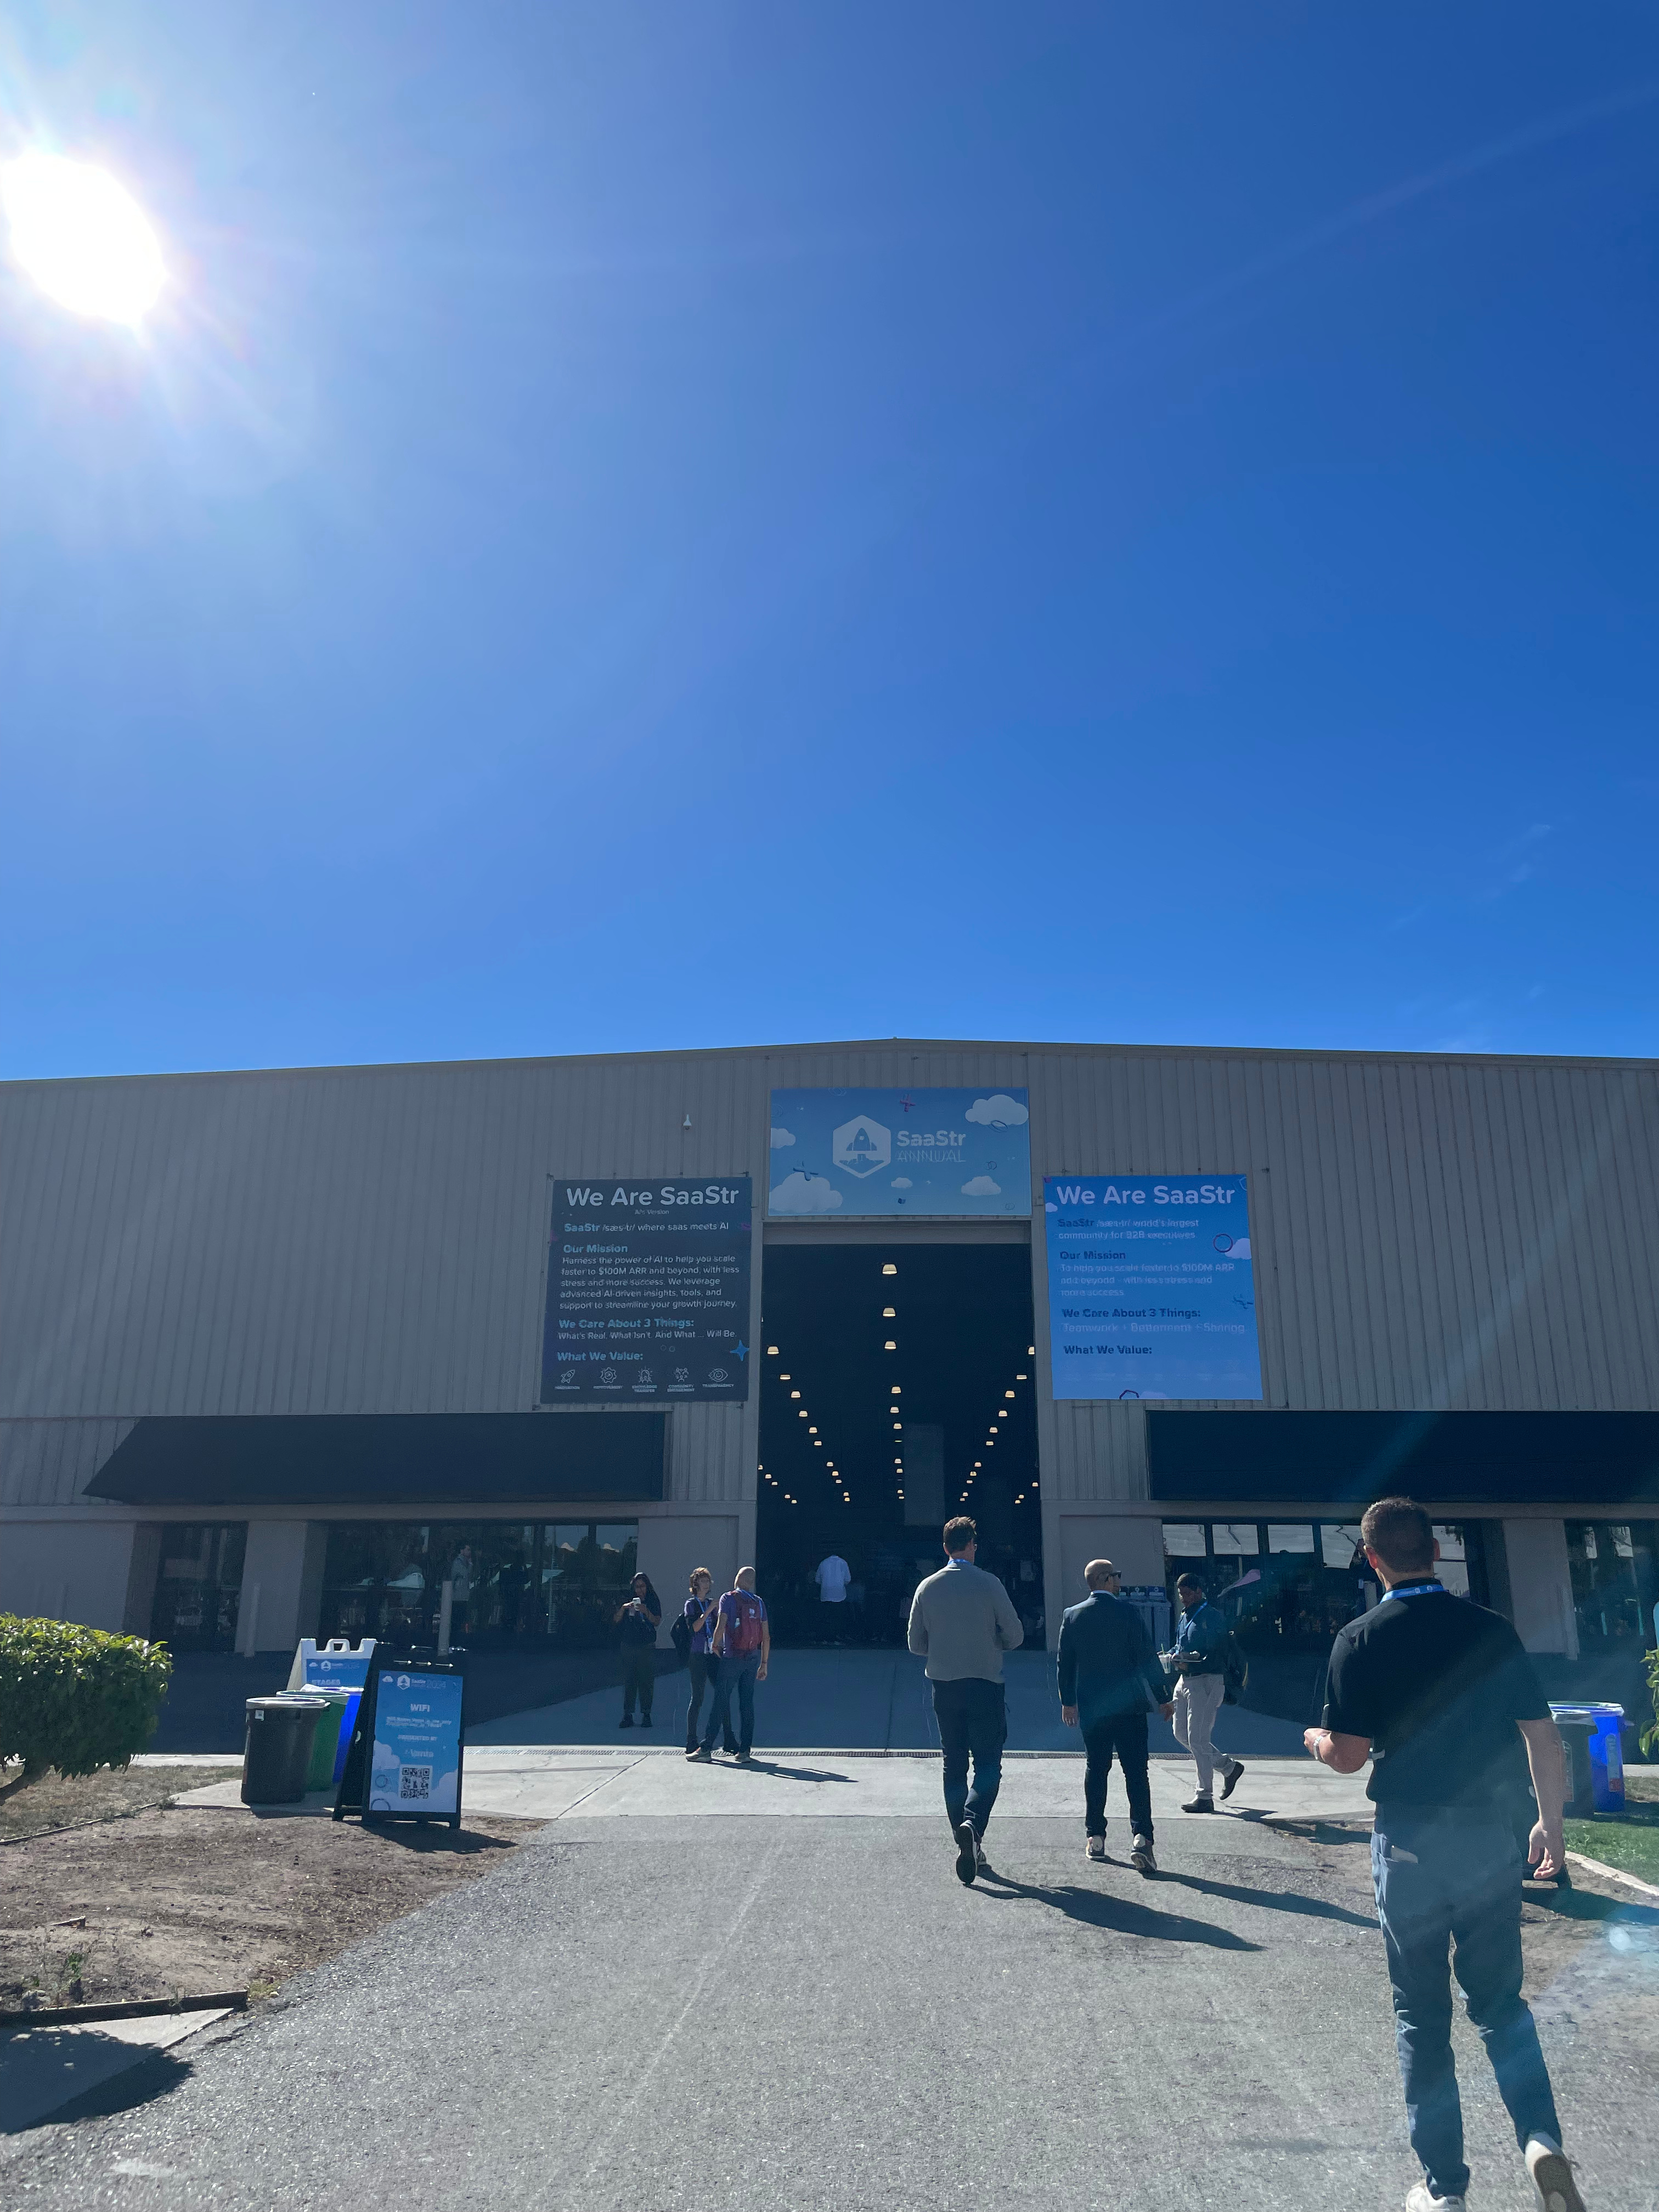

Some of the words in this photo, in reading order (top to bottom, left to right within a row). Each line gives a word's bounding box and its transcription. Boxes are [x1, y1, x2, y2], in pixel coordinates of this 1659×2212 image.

[896, 1130, 966, 1147] SaaStr
[896, 1149, 966, 1163] ANNUAL
[566, 1188, 603, 1206] We
[611, 1187, 653, 1206] Are
[660, 1186, 739, 1205] SaaStr
[1056, 1186, 1095, 1204] We
[1103, 1186, 1146, 1204] Are
[1154, 1185, 1235, 1204] SaaStr
[564, 1223, 600, 1232] SaaStr
[637, 1223, 665, 1232] where
[719, 1222, 729, 1230] AI
[1057, 1218, 1094, 1227] SaaStr
[1166, 1219, 1199, 1228] largest
[1058, 1232, 1108, 1240] community
[563, 1244, 583, 1253] Our
[586, 1243, 628, 1253] Mission
[614, 1256, 641, 1266] power
[644, 1255, 652, 1263] of
[654, 1255, 663, 1263] AI
[675, 1255, 694, 1264] help
[696, 1256, 712, 1265] you
[1060, 1251, 1080, 1260] Our
[1083, 1251, 1126, 1260] Mission
[561, 1267, 585, 1276] faster
[599, 1267, 627, 1276] $100M
[667, 1266, 701, 1276] beyond,
[703, 1265, 721, 1273] with
[723, 1265, 740, 1273] less
[1096, 1265, 1113, 1273] you
[560, 1279, 586, 1287] stress
[588, 1278, 604, 1286] and
[668, 1277, 681, 1285] We
[683, 1277, 720, 1287] leverage
[560, 1289, 602, 1298] advanced
[603, 1289, 641, 1298] AI-driven
[644, 1289, 678, 1299] insights,
[680, 1289, 704, 1297] tools,
[560, 1300, 592, 1310] support
[605, 1300, 649, 1309] streamline
[651, 1301, 670, 1310] your
[672, 1299, 702, 1310] growth
[703, 1299, 737, 1309] journey.
[1062, 1308, 1079, 1317] We
[1082, 1308, 1109, 1317] Care
[1112, 1308, 1147, 1317] About
[1149, 1308, 1156, 1317] 3
[1160, 1308, 1201, 1319] Things:
[558, 1319, 575, 1328] We
[578, 1319, 605, 1328] Care
[607, 1319, 641, 1328] About
[644, 1318, 651, 1328] 3
[653, 1318, 695, 1329] Things:
[1063, 1323, 1118, 1332] Teamwork
[557, 1331, 586, 1340] What's
[674, 1330, 696, 1339] What
[706, 1330, 721, 1338] Will
[1064, 1345, 1093, 1354] What
[1097, 1345, 1114, 1354] We
[1117, 1345, 1152, 1355] Value:
[557, 1351, 586, 1361] What
[589, 1351, 606, 1361] We
[609, 1351, 643, 1361] Value:
[410, 1703, 430, 1712] WIFI
